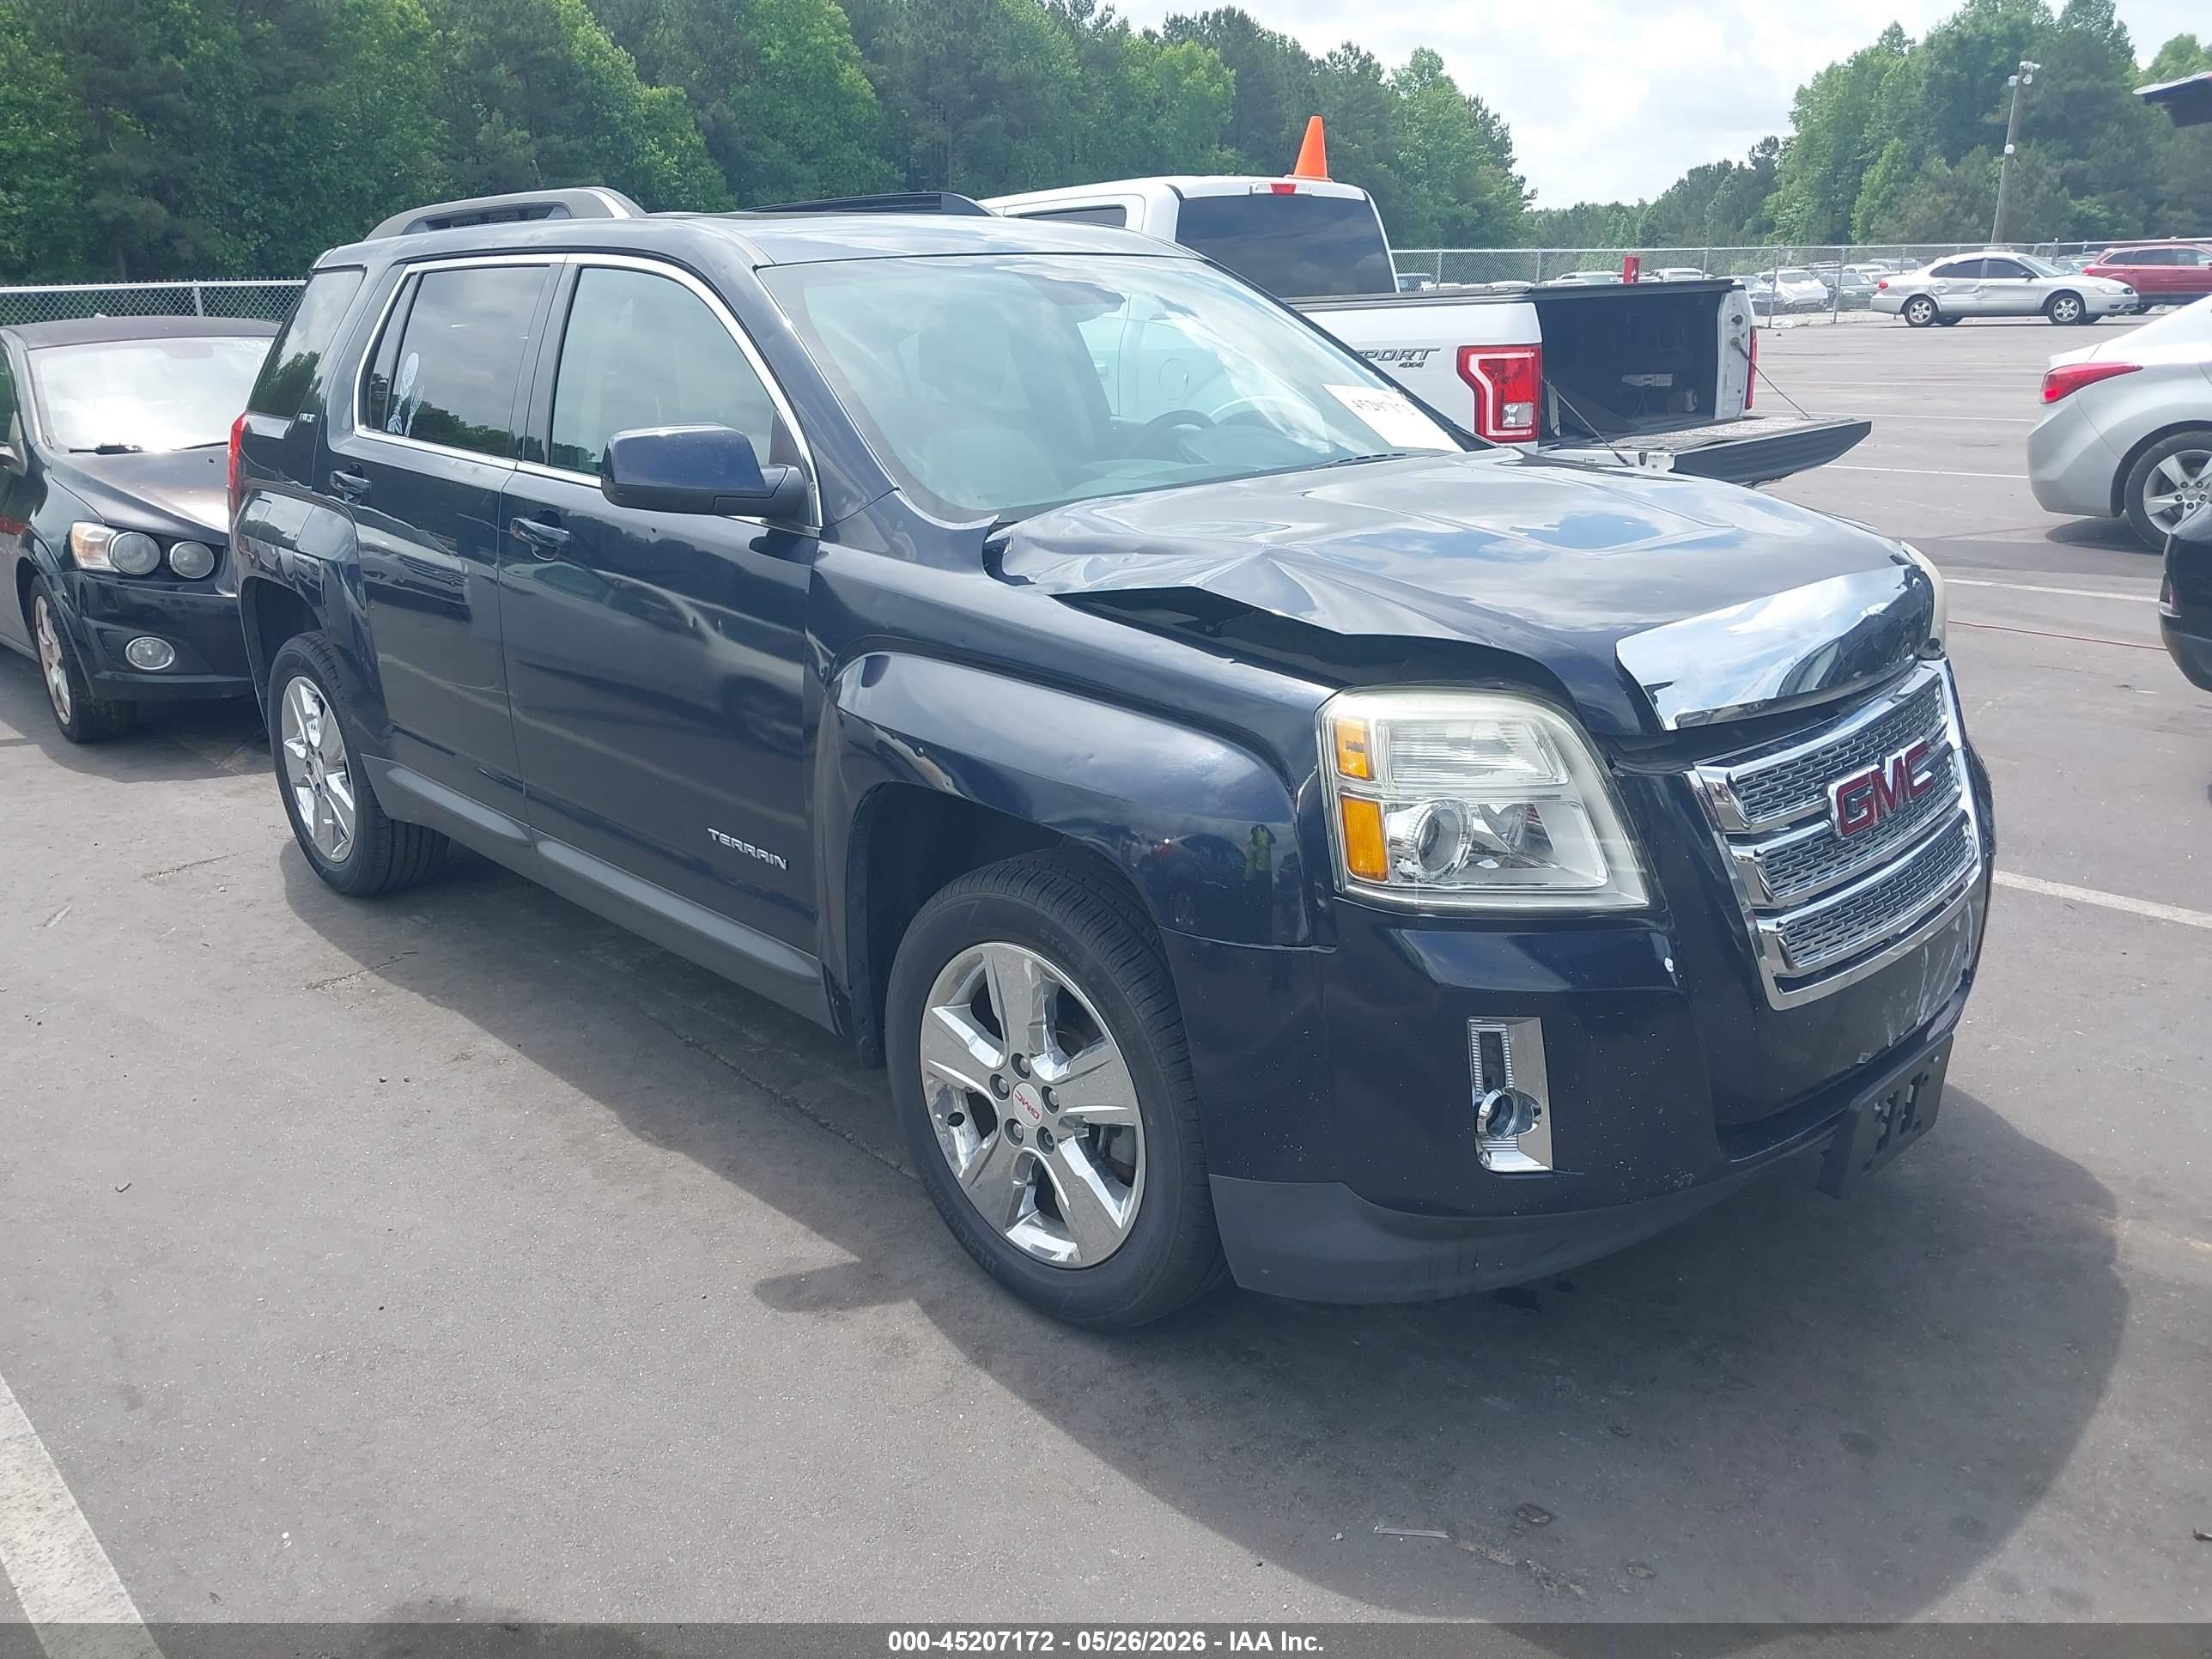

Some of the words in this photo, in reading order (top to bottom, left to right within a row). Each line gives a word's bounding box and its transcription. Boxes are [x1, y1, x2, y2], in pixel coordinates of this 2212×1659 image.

[1357, 348, 1441, 361] PORT
[1827, 736, 1934, 839] GMC
[707, 827, 788, 871] TERRAIN
[1014, 1089, 1042, 1120] GMC
